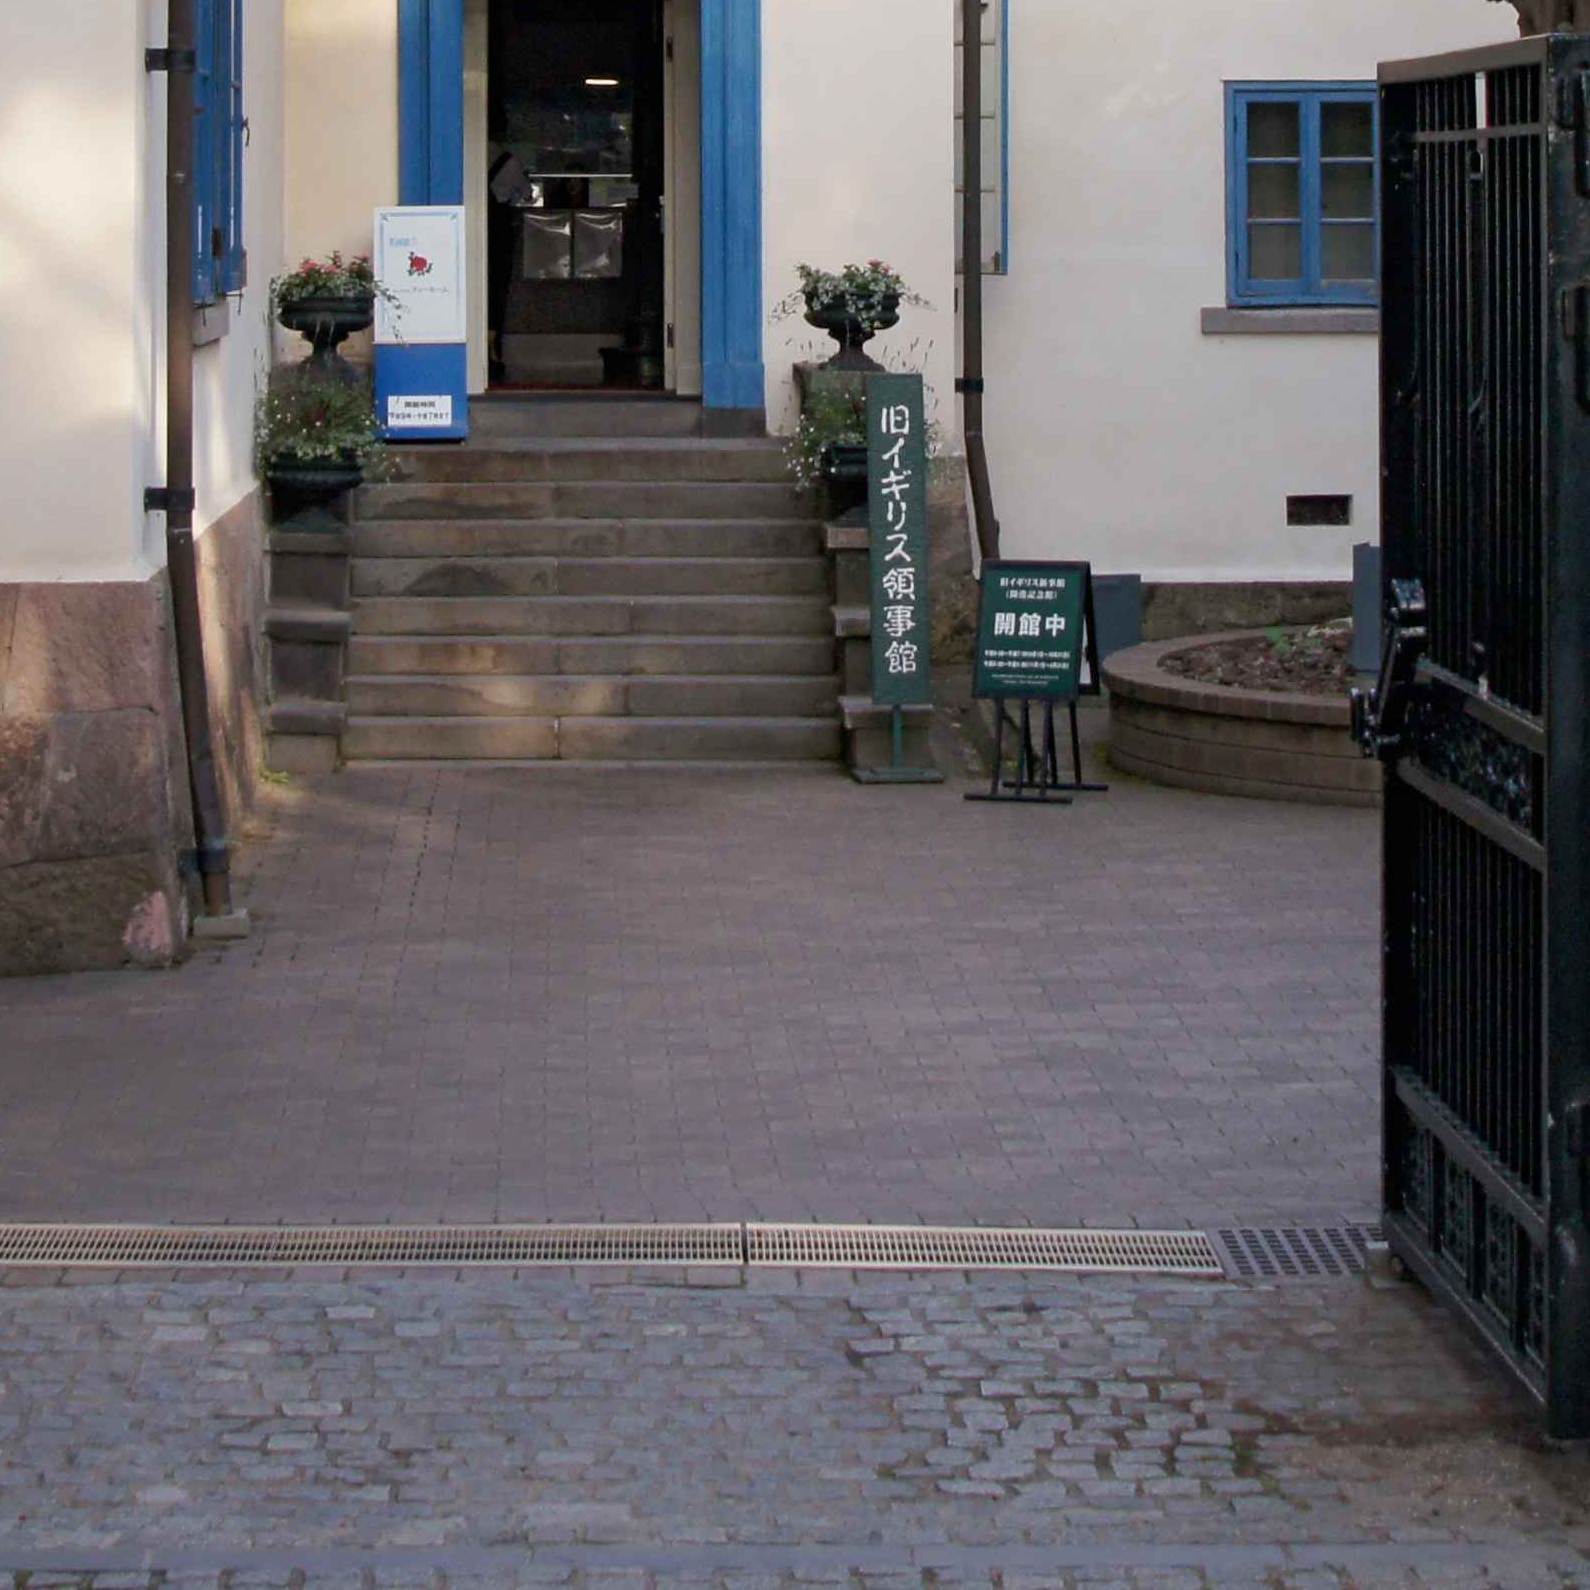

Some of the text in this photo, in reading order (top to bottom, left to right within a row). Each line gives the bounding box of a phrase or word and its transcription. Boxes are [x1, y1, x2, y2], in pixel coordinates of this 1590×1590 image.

[880, 405, 919, 674] 旧イギリス領事館
[993, 612, 1067, 638] 開館中
